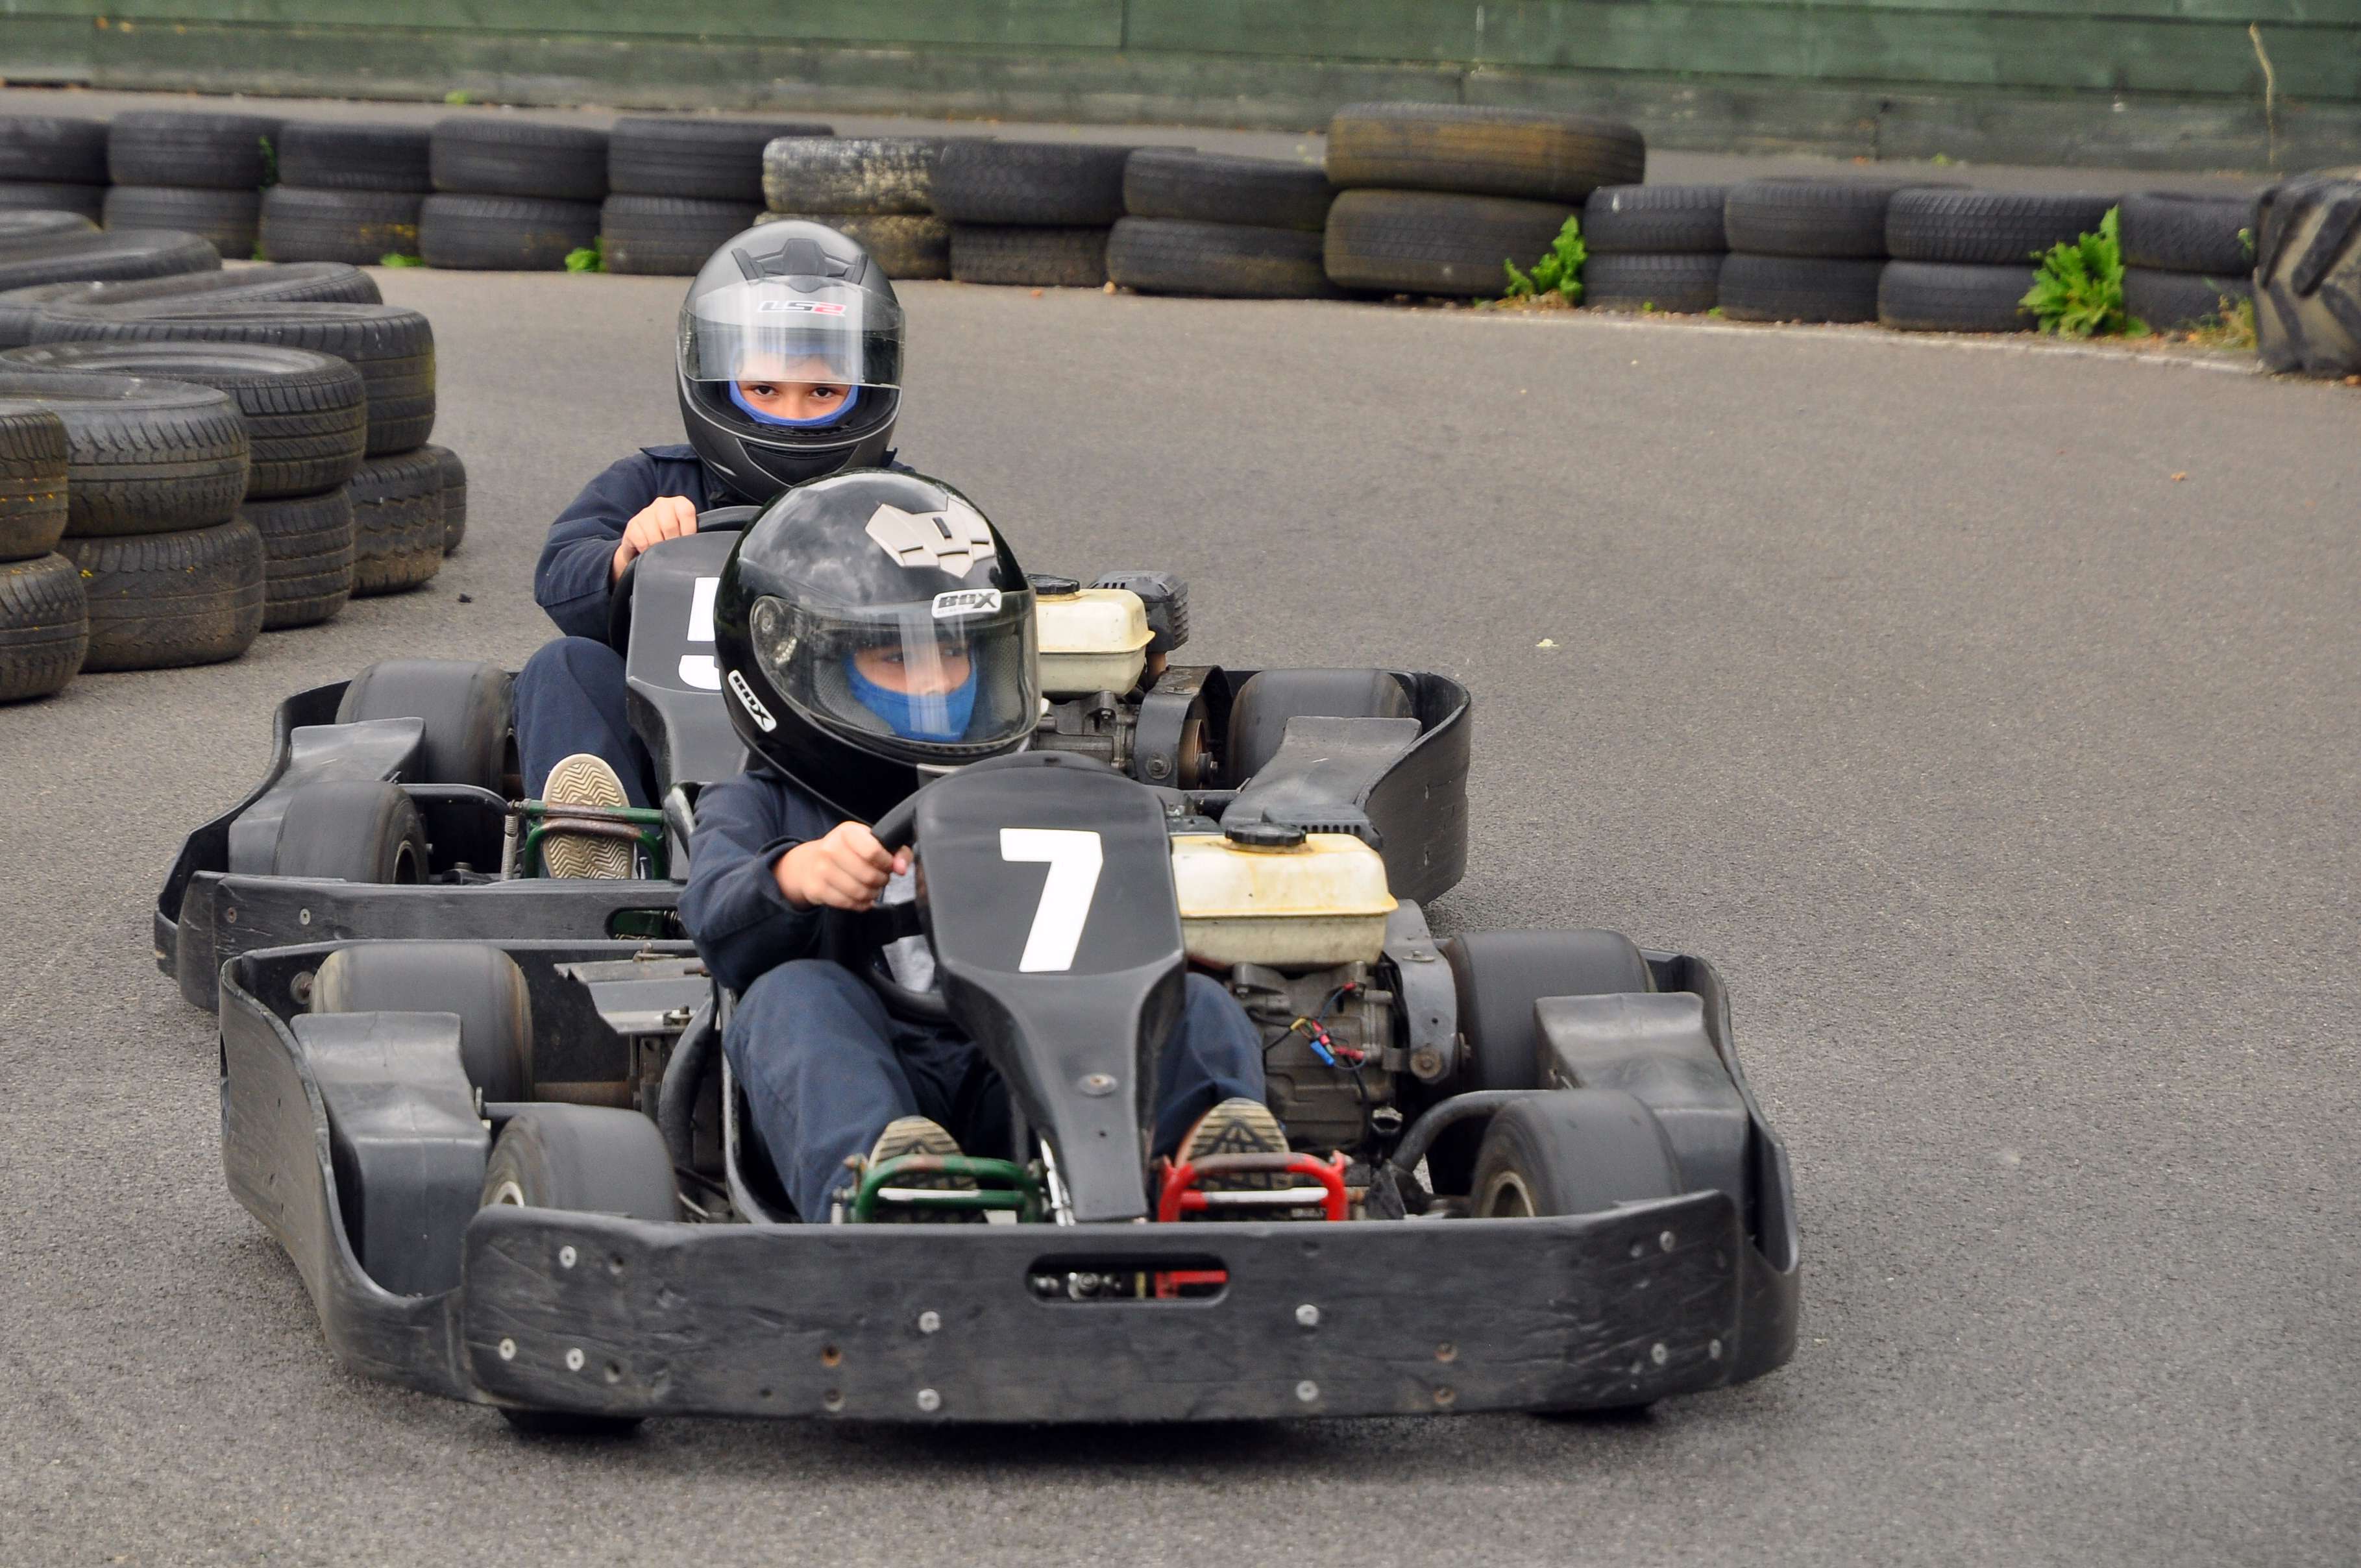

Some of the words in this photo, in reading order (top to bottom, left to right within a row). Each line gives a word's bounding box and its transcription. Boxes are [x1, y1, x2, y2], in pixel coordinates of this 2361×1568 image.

[759, 300, 846, 316] LS2
[938, 592, 997, 609] BOX
[999, 827, 1103, 972] 7
